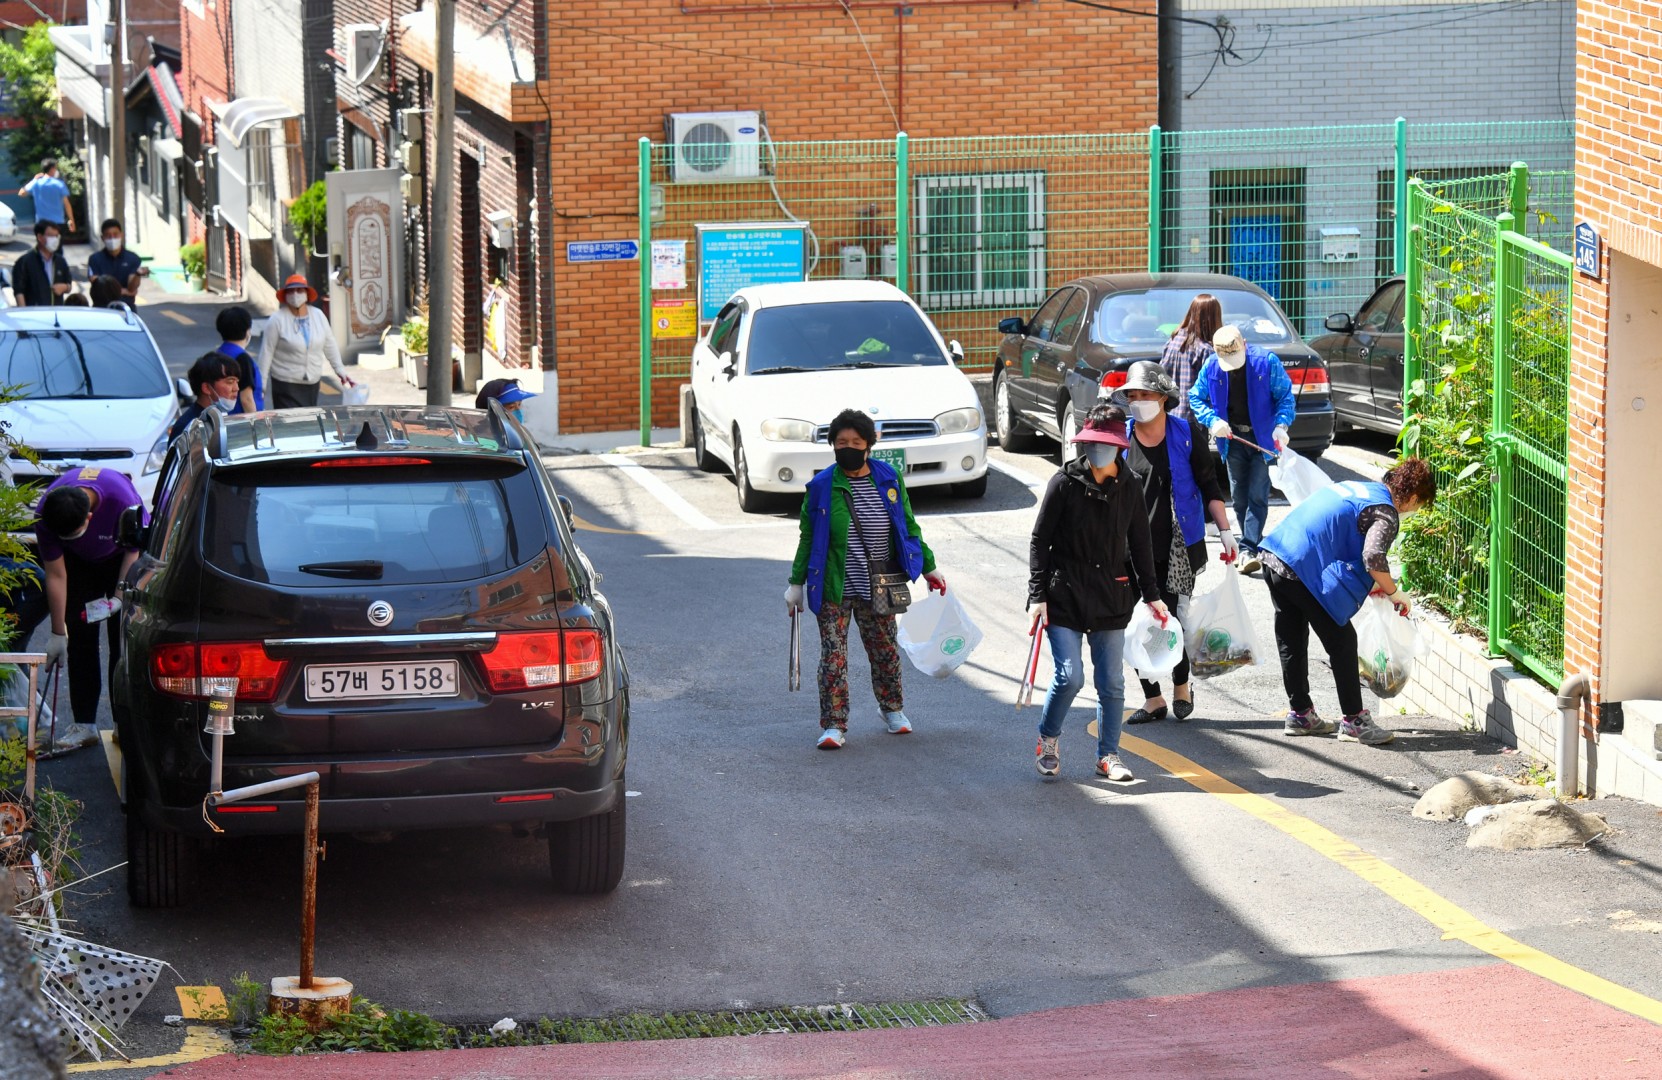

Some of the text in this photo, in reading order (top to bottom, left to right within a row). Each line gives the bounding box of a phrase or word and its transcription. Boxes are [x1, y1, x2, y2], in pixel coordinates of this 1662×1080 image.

[1579, 246, 1594, 270] 145
[321, 666, 444, 693] 57버 5158
[521, 700, 555, 711] LV5
